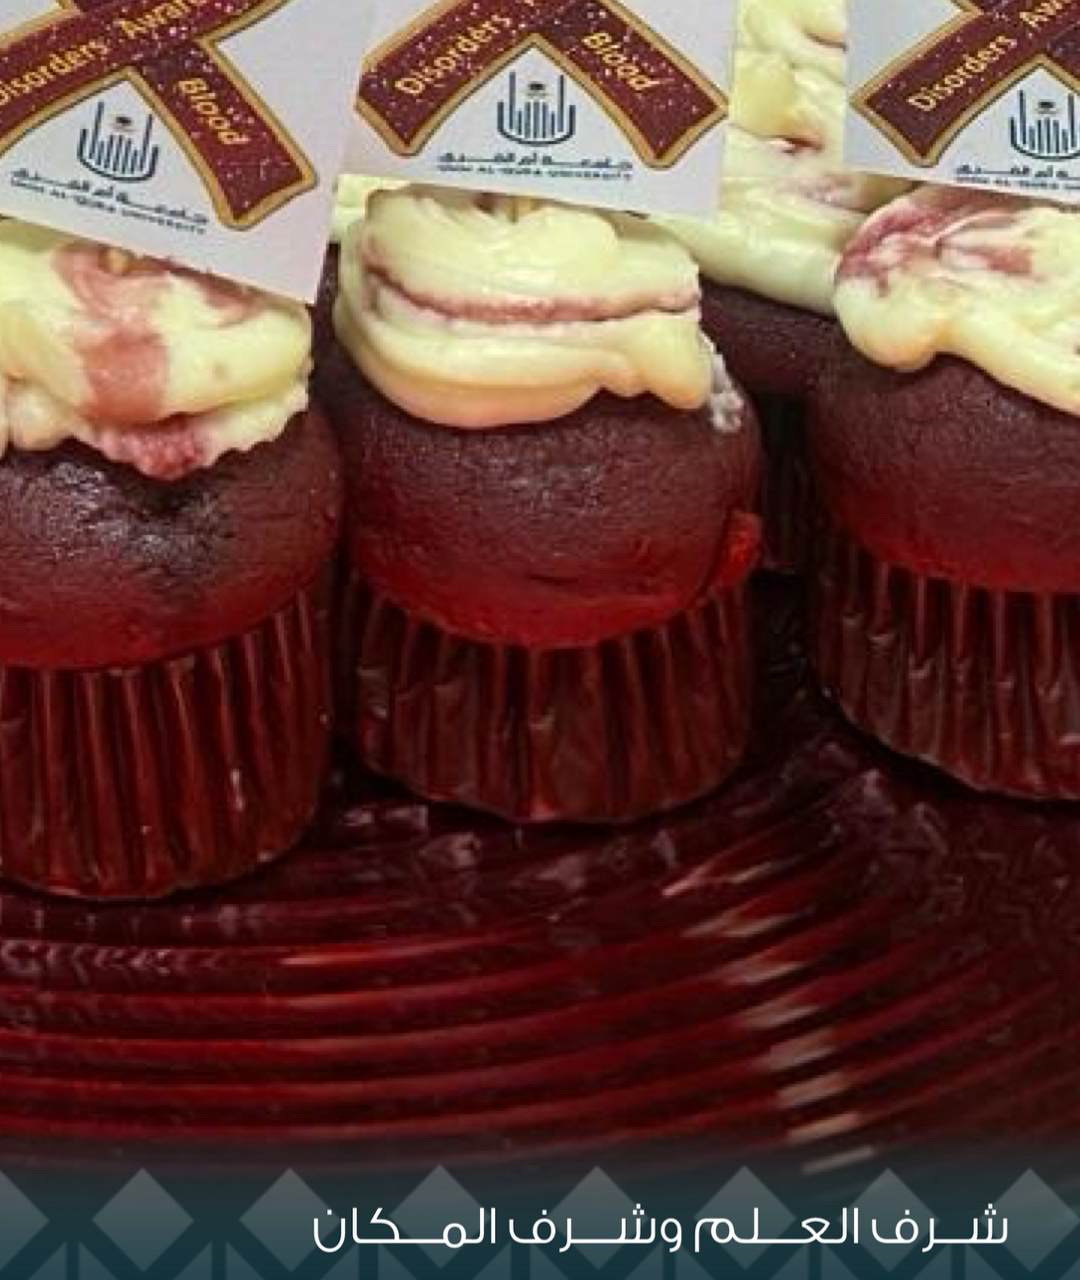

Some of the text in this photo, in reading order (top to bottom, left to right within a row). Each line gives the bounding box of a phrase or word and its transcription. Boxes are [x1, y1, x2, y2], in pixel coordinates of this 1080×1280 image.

[393, 10, 513, 97] Disorders
[582, 29, 662, 92] Blood
[907, 34, 1019, 112] Disorders
[176, 78, 252, 148] Blood
